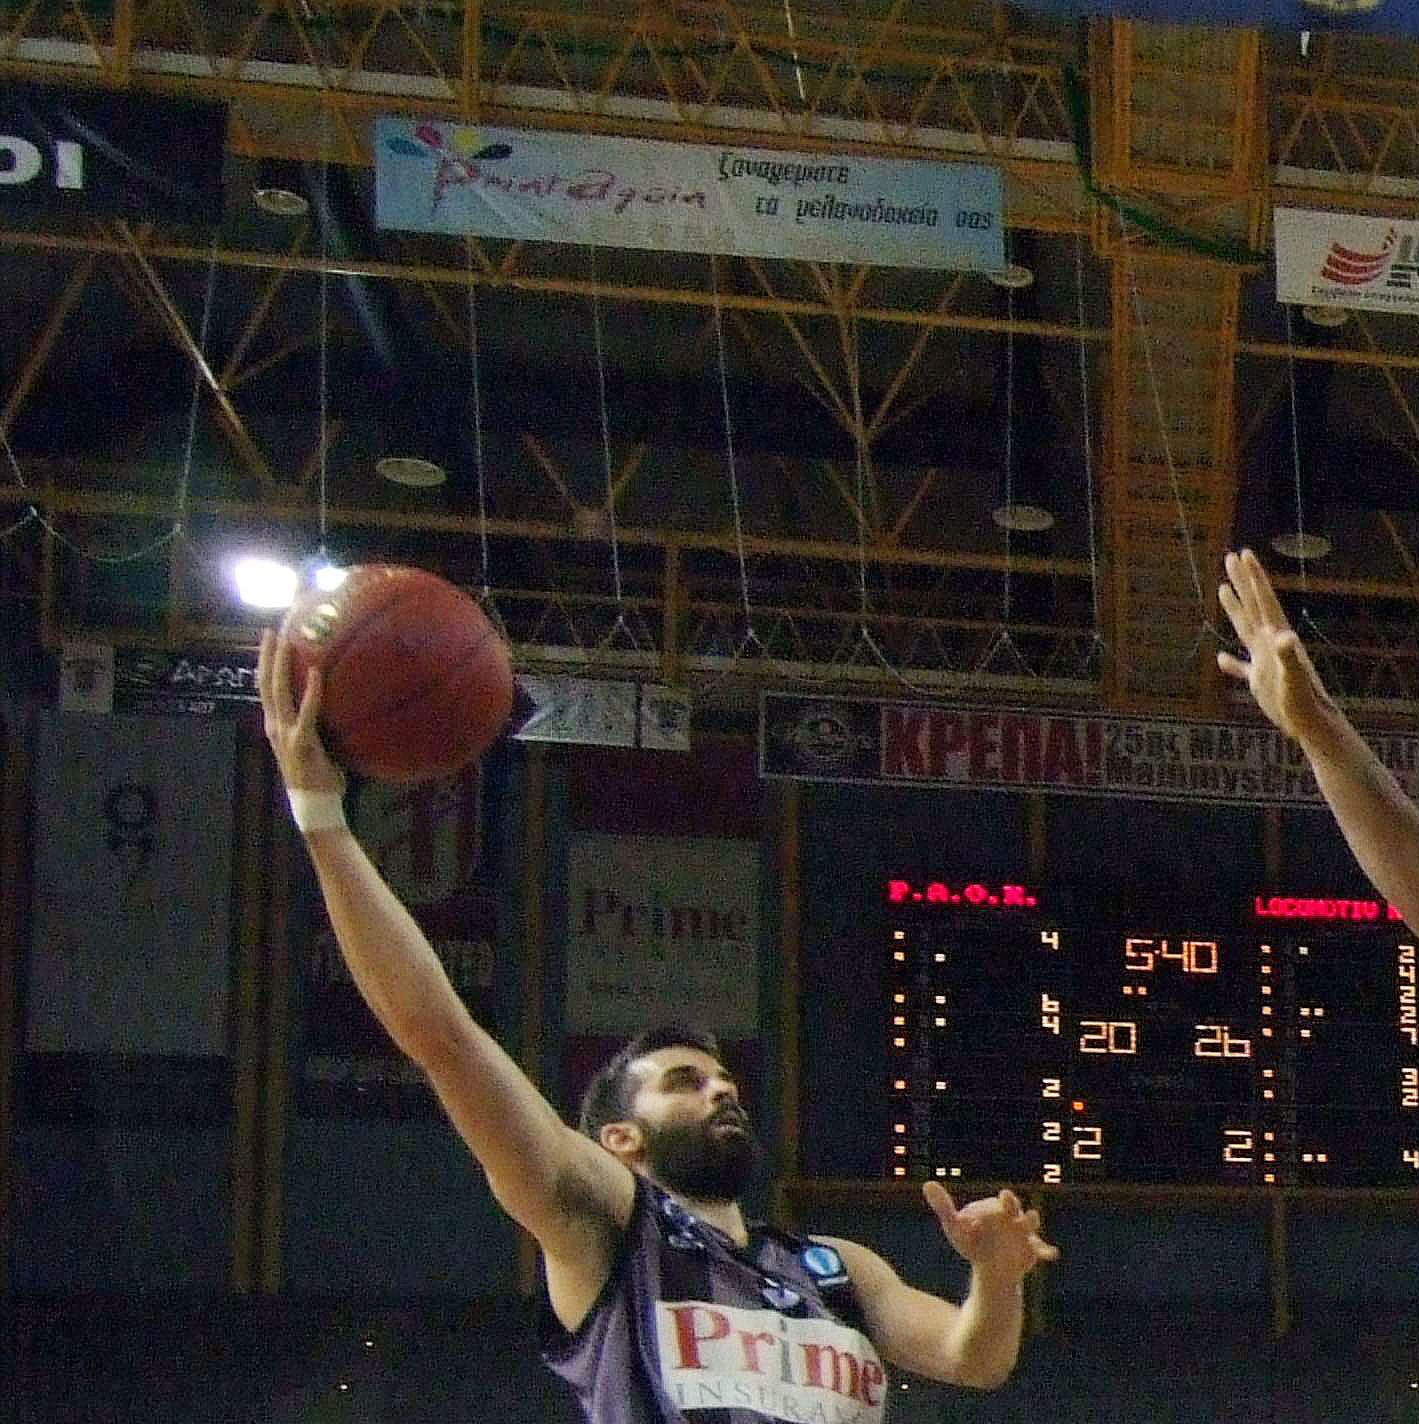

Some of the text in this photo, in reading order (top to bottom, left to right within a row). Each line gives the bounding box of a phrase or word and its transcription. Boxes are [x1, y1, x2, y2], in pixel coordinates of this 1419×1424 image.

[578, 887, 748, 942] Prime
[1041, 931, 1059, 950] 4
[1042, 993, 1060, 1013] 6
[1042, 1014, 1060, 1035] 4
[1080, 1020, 1137, 1055] 20
[1194, 1024, 1252, 1058] 26
[1042, 1077, 1061, 1098] 2
[1042, 1121, 1062, 1141] 2
[1072, 1127, 1103, 1160] 2
[1223, 1130, 1253, 1162] 2
[1043, 1163, 1062, 1184] 2
[665, 1305, 886, 1408] Prime
